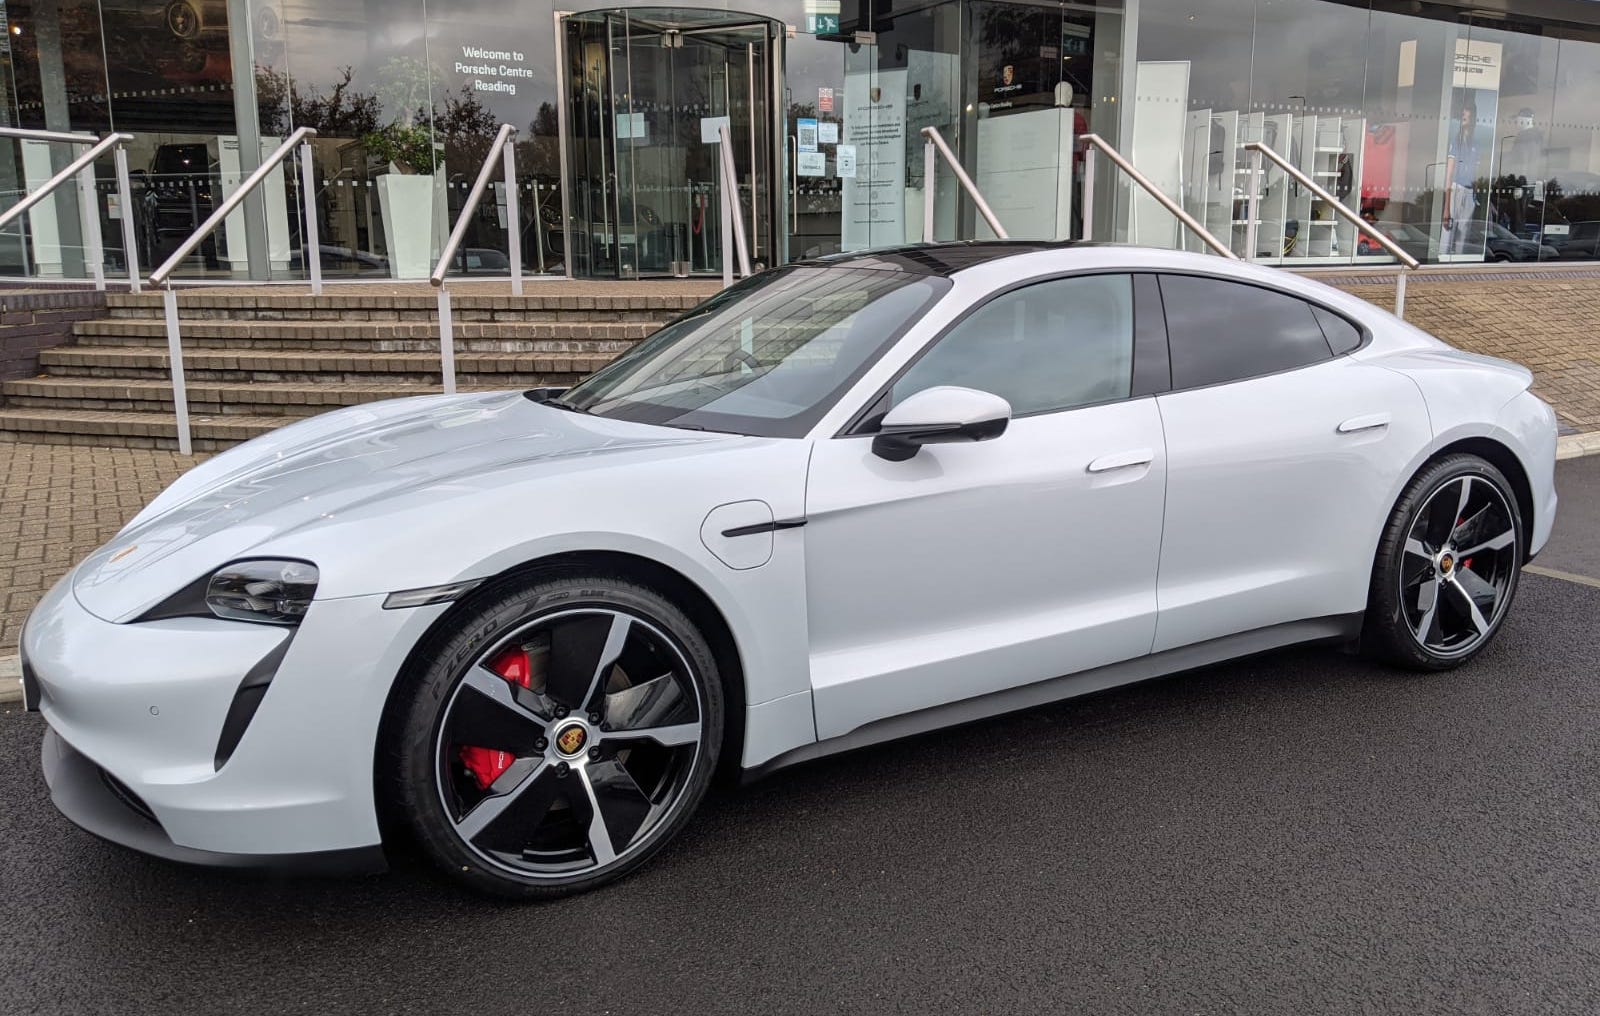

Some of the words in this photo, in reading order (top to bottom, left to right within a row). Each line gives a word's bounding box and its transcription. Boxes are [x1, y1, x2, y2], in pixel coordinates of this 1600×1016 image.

[462, 46, 511, 60] Welcome
[512, 51, 524, 61] to
[455, 62, 497, 75] Porsche
[499, 65, 533, 77] Centre
[475, 80, 516, 95] Reading
